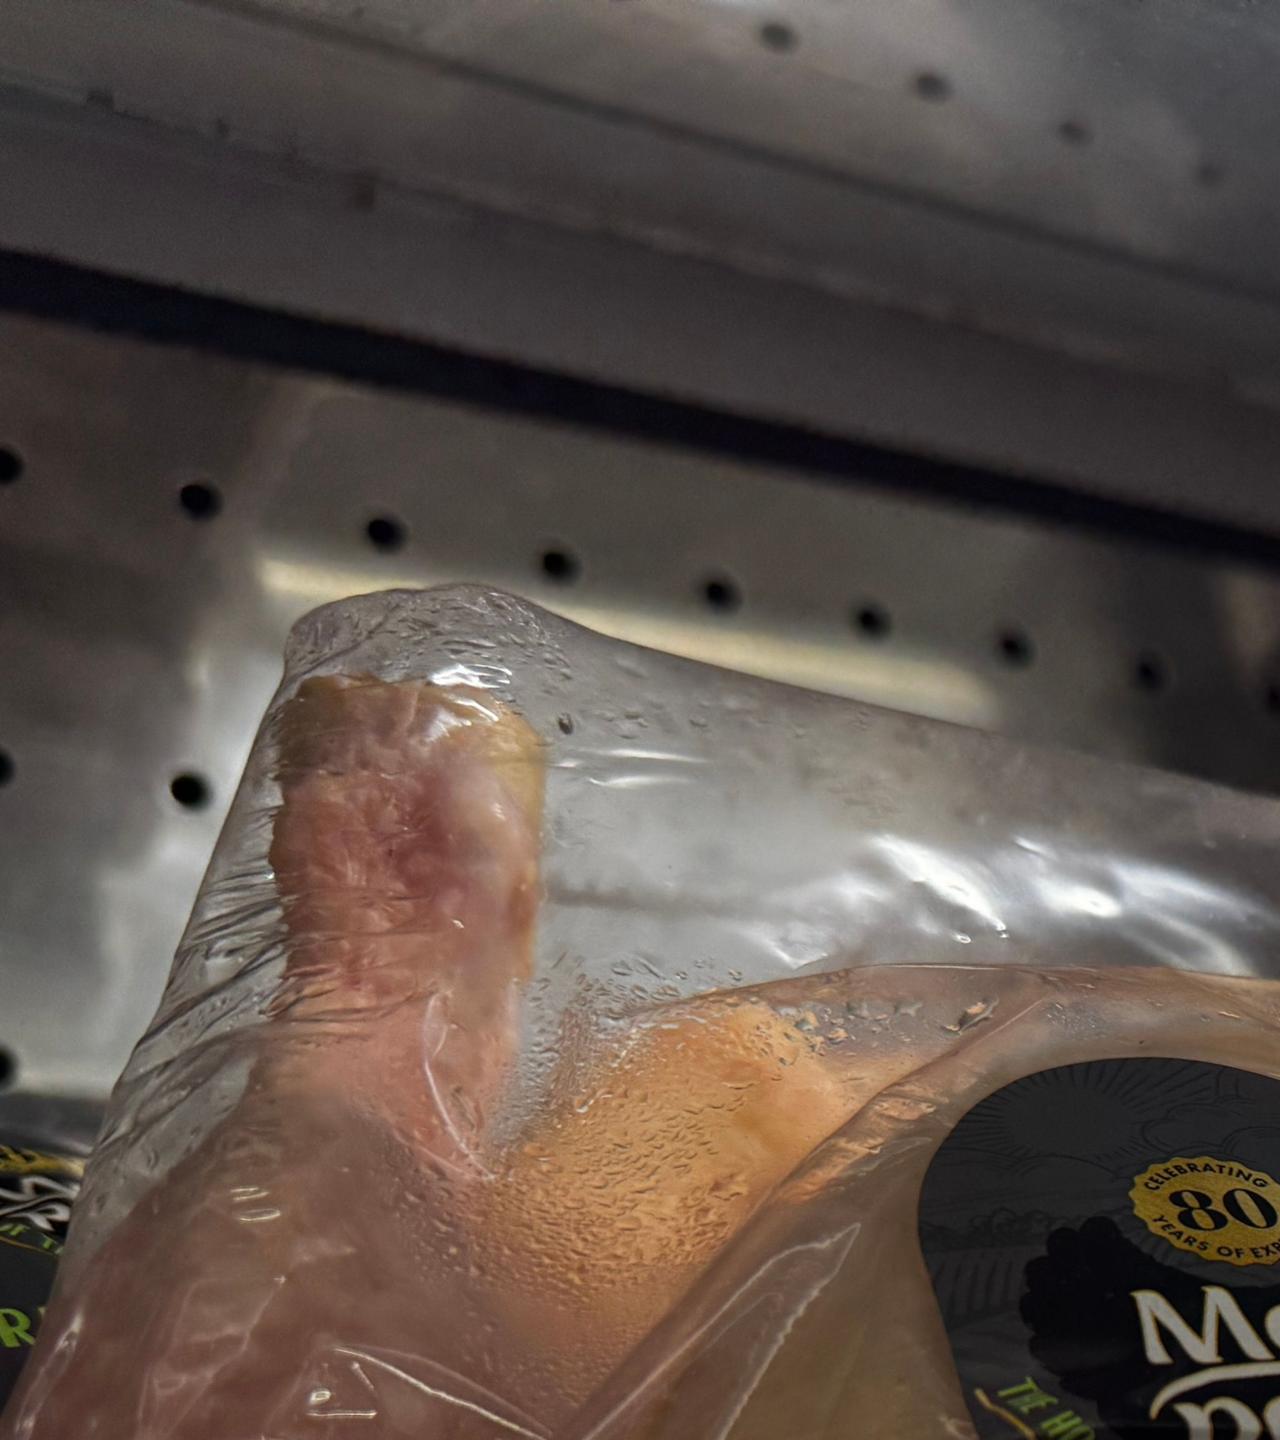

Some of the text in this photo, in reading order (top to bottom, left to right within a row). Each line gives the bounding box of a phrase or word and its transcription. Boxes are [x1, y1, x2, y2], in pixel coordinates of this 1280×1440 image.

[1144, 1162, 1268, 1191] CELEBRATING
[1168, 1187, 1278, 1231] 80
[1152, 1214, 1210, 1251] YEARS
[1216, 1246, 1246, 1259] OF
